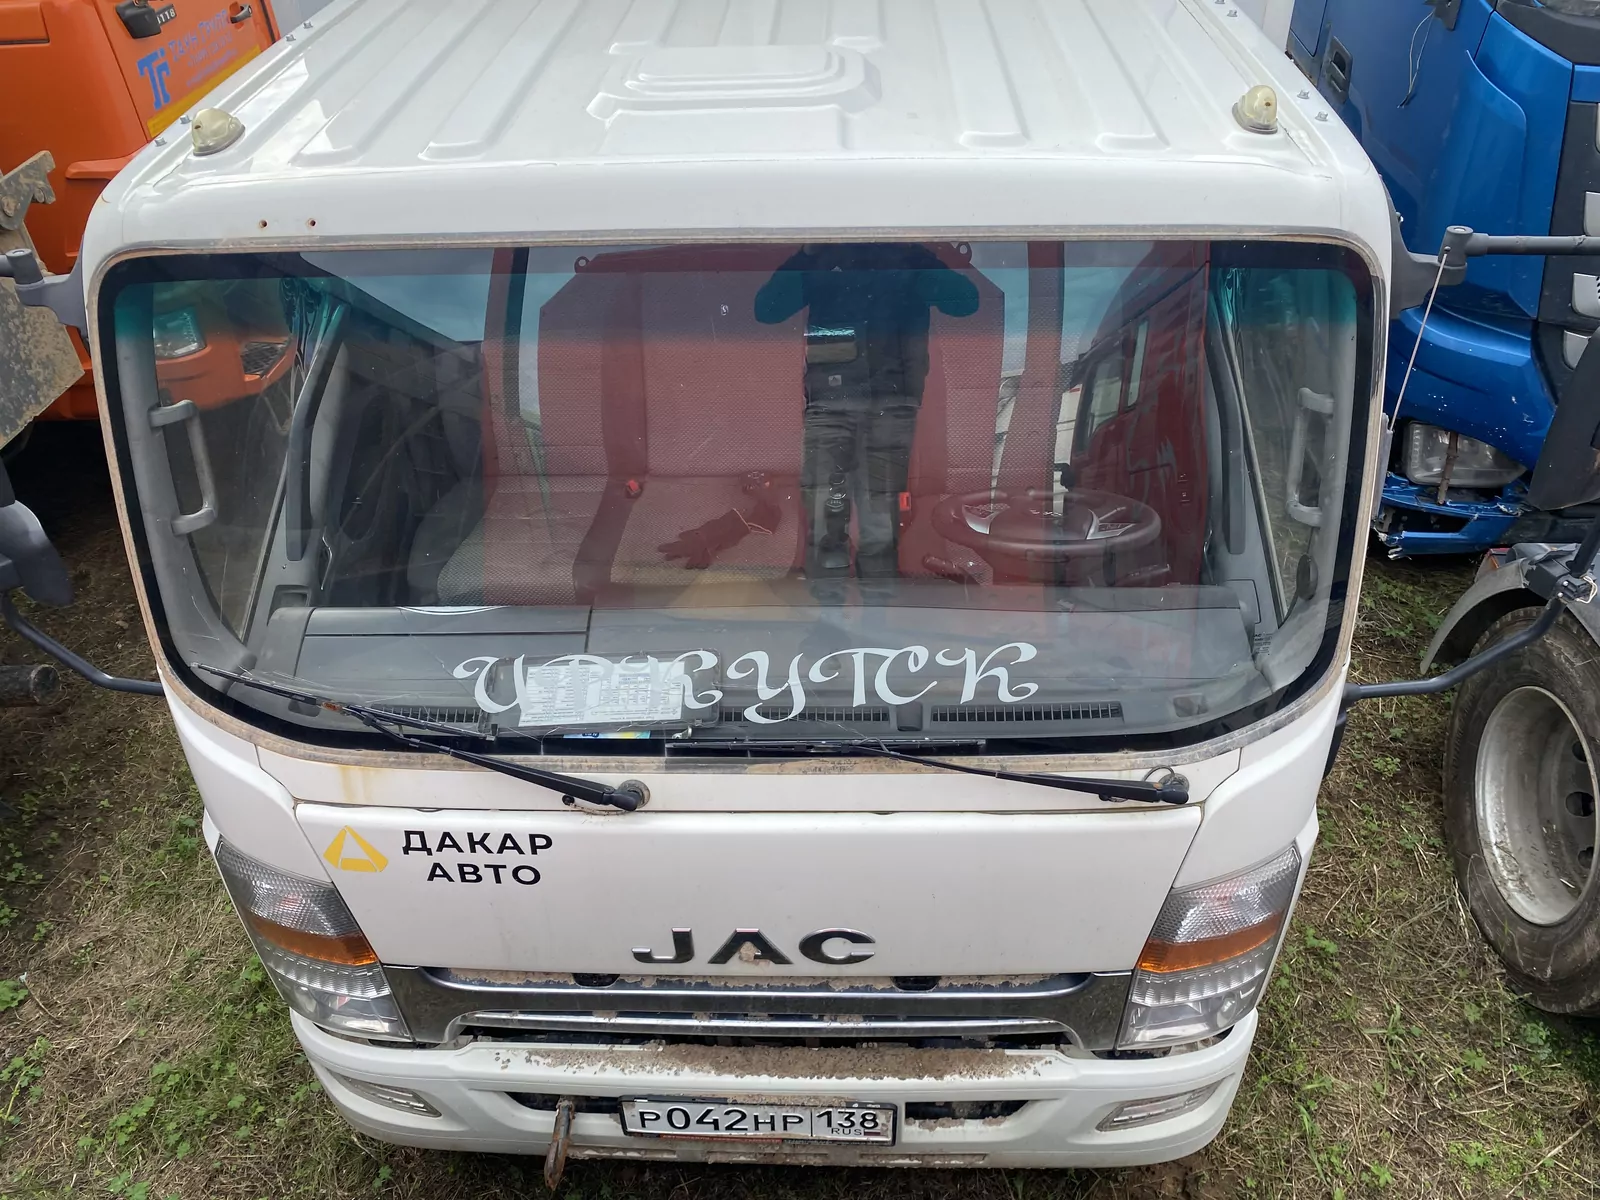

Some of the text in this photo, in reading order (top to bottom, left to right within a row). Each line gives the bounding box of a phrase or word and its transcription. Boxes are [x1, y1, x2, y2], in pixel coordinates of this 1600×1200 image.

[453, 642, 1039, 724] ИРКУТСК
[402, 830, 553, 856] ДАКАР
[427, 862, 541, 885] АВТО
[631, 927, 876, 964] JAC
[816, 1109, 879, 1129] 138
[831, 1127, 862, 1136] RUS
